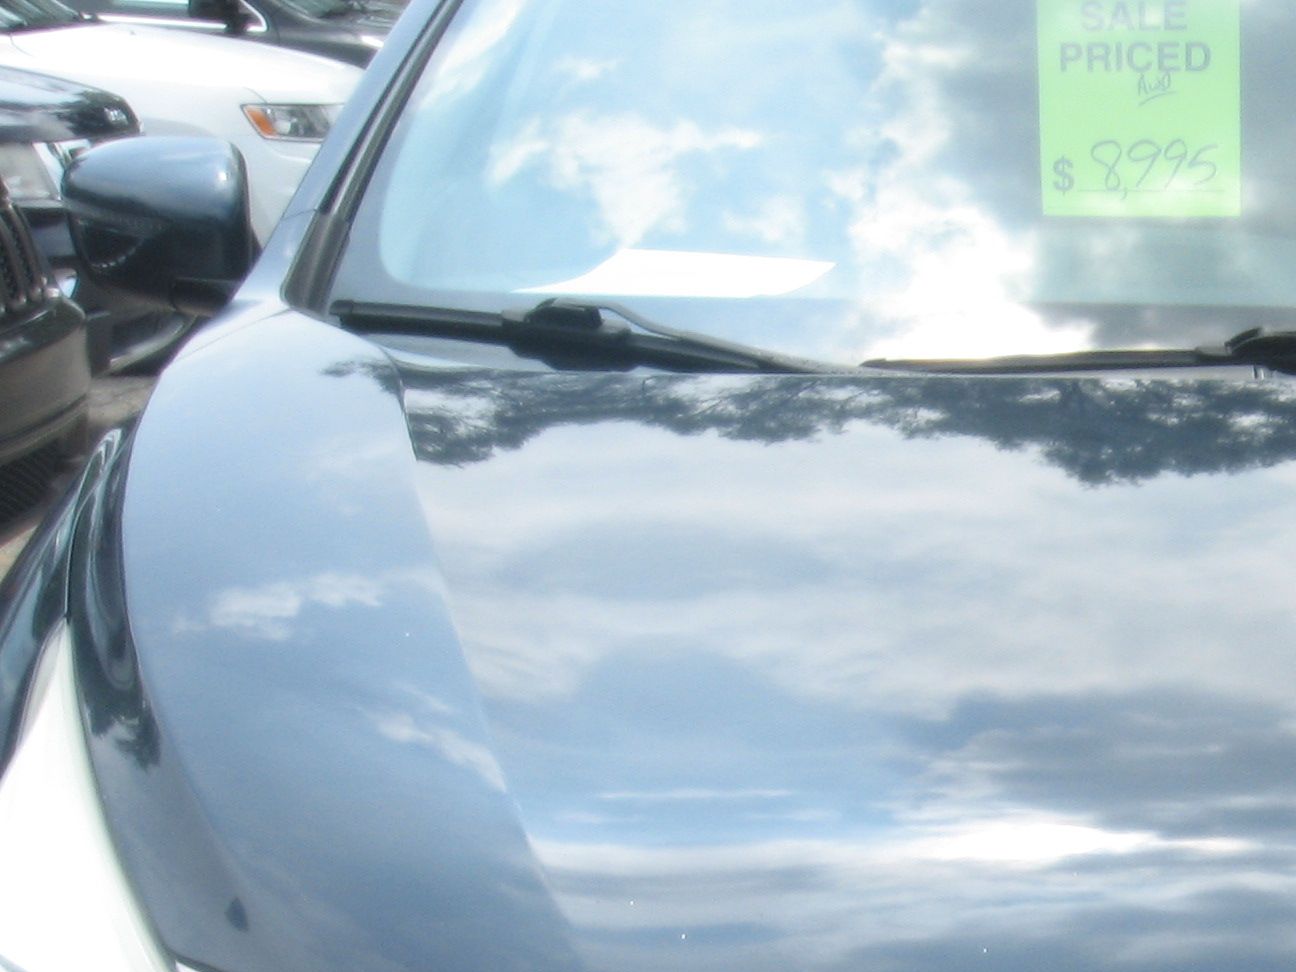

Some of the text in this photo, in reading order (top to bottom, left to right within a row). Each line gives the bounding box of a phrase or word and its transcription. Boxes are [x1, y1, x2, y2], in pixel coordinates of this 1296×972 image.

[1080, 0, 1188, 31] SALE
[1059, 41, 1212, 72] PRICED
[1052, 155, 1075, 195] $
